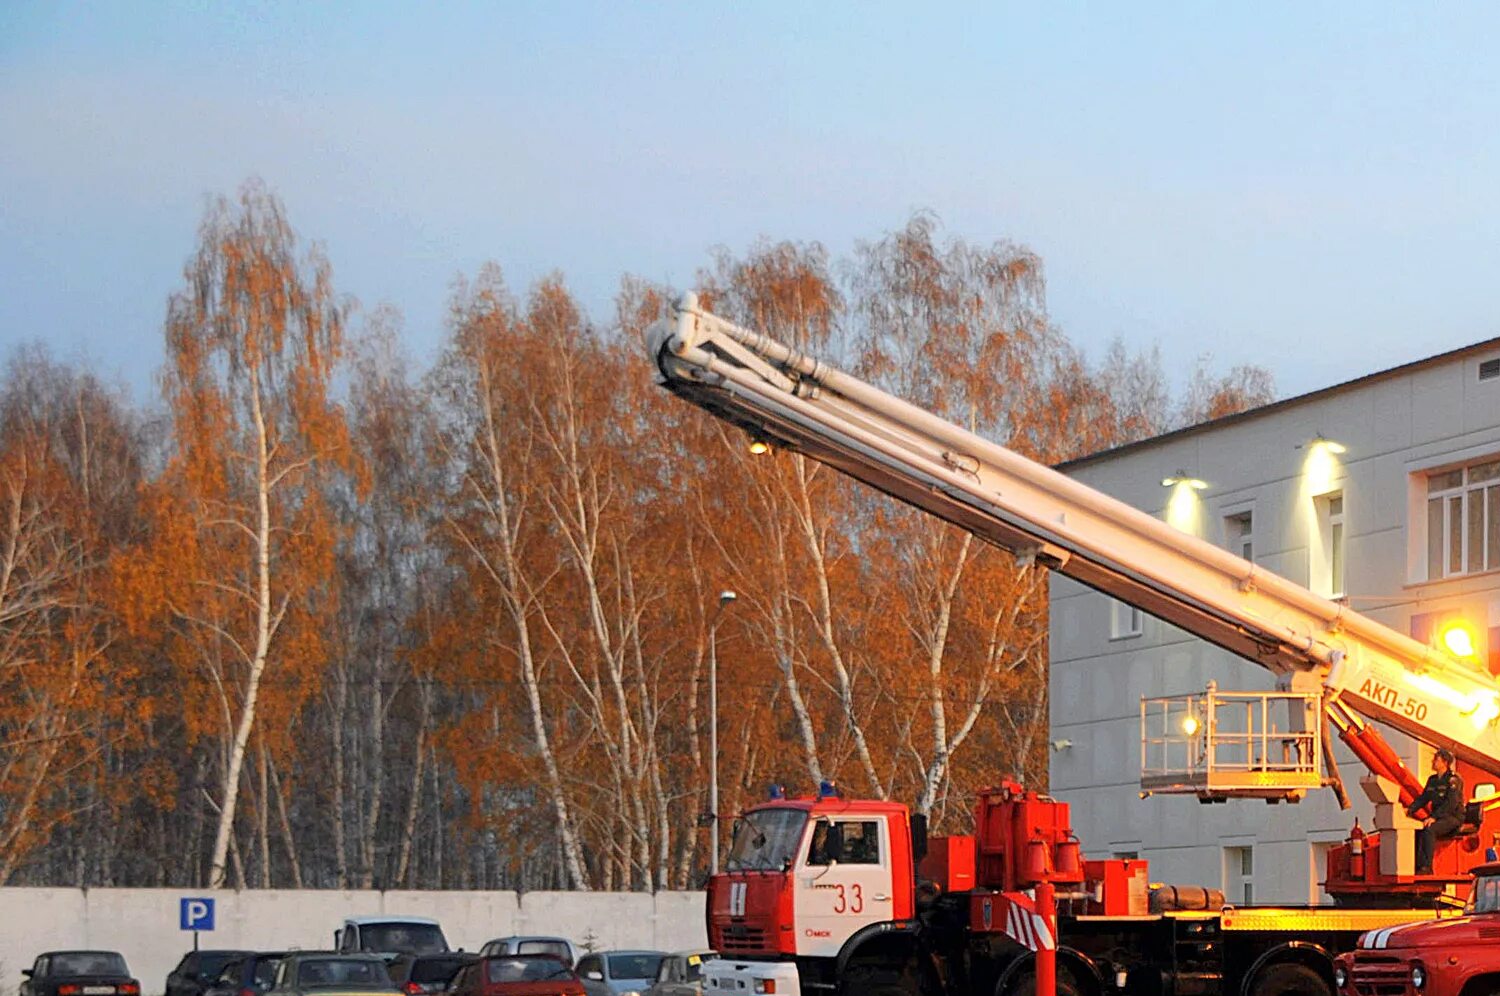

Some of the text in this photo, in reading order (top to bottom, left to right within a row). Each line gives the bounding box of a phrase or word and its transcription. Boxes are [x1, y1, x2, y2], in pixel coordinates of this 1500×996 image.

[1360, 678, 1428, 721] АКП-50
[834, 884, 863, 913] 33
[188, 901, 208, 926] P
